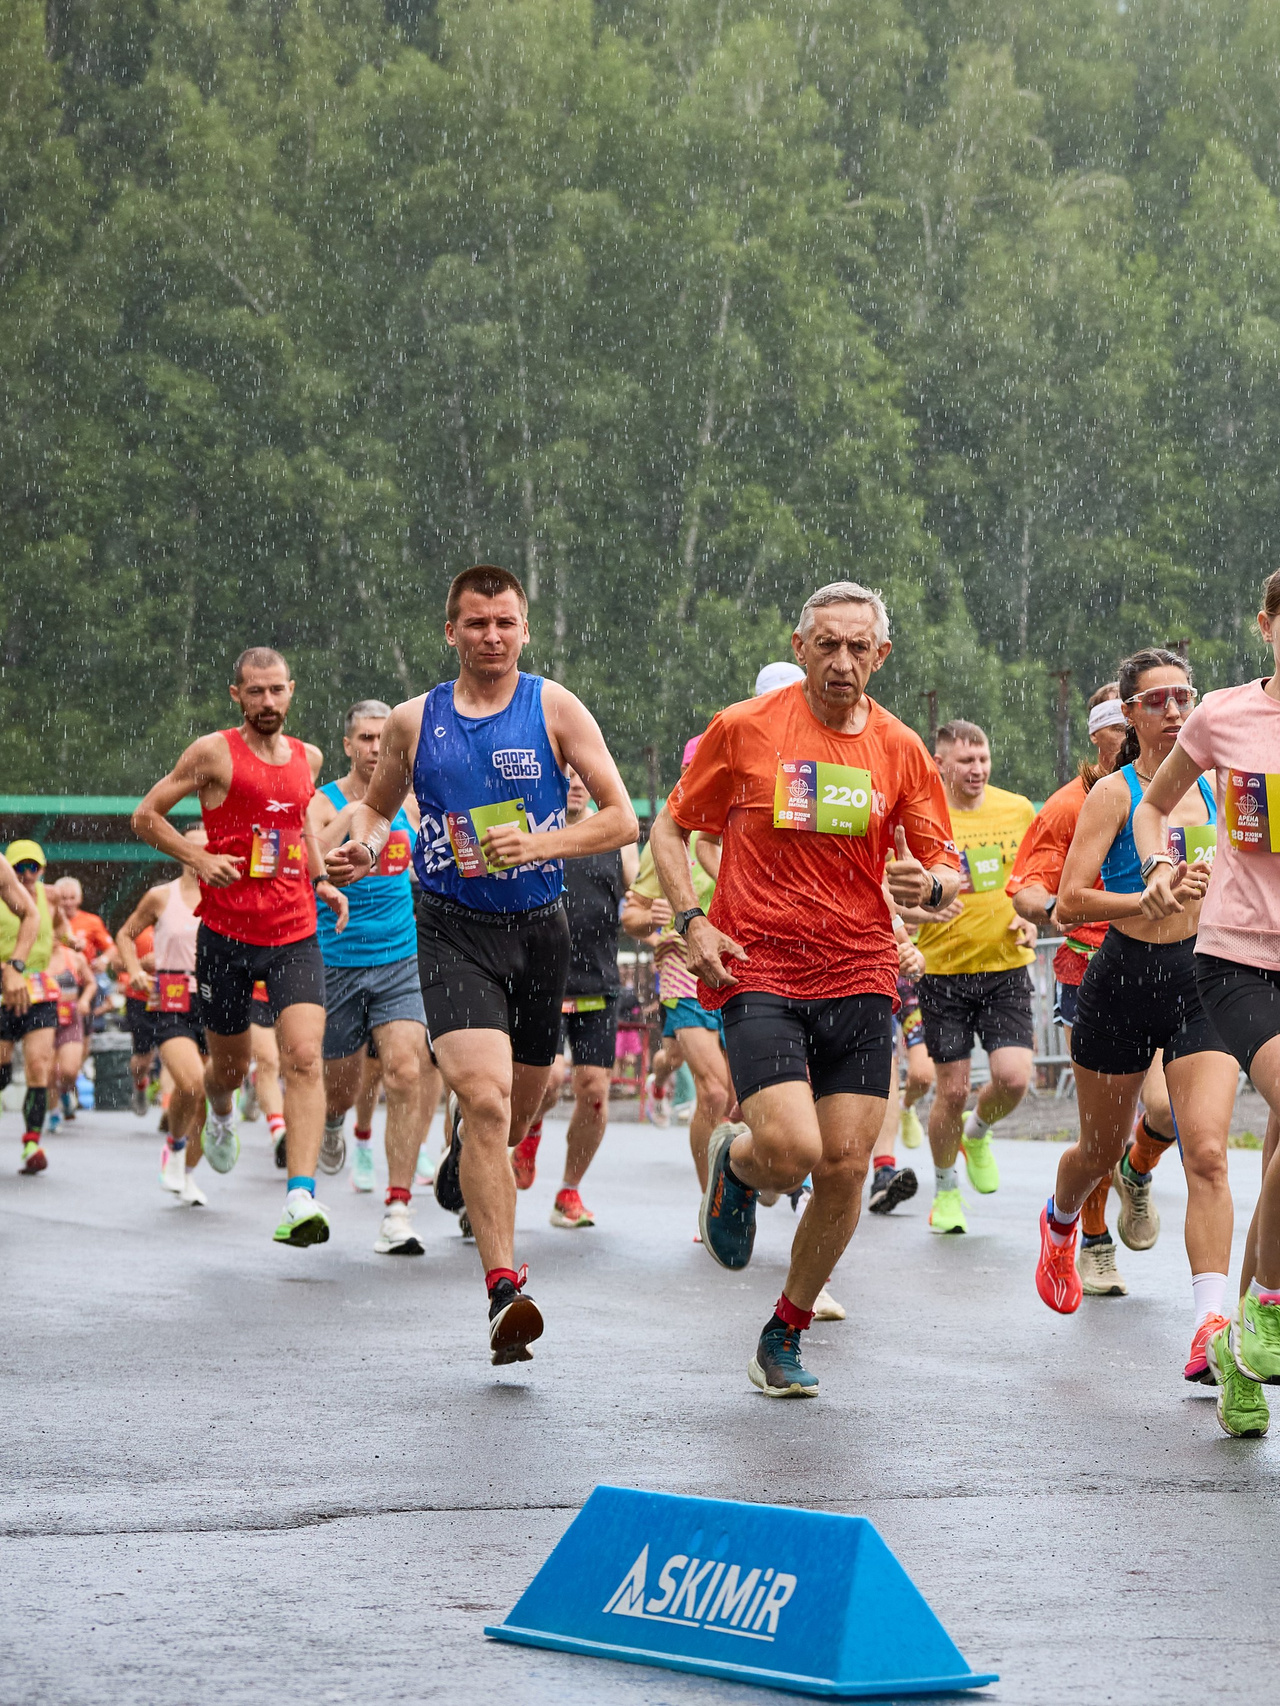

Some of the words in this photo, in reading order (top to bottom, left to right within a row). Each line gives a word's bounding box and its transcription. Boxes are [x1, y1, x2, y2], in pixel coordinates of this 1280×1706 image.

[494, 751, 534, 766] СПОРТ
[503, 764, 540, 778] СОЮЗ
[789, 797, 808, 805] АРЕНА
[822, 784, 868, 809] 220
[778, 810, 794, 820] 28
[1237, 814, 1259, 822] АРЕНА
[831, 818, 838, 827] 5
[1231, 829, 1244, 841] 28
[287, 844, 301, 860] 14
[387, 842, 407, 859] 33
[974, 858, 1000, 875] 183
[166, 983, 185, 998] 97
